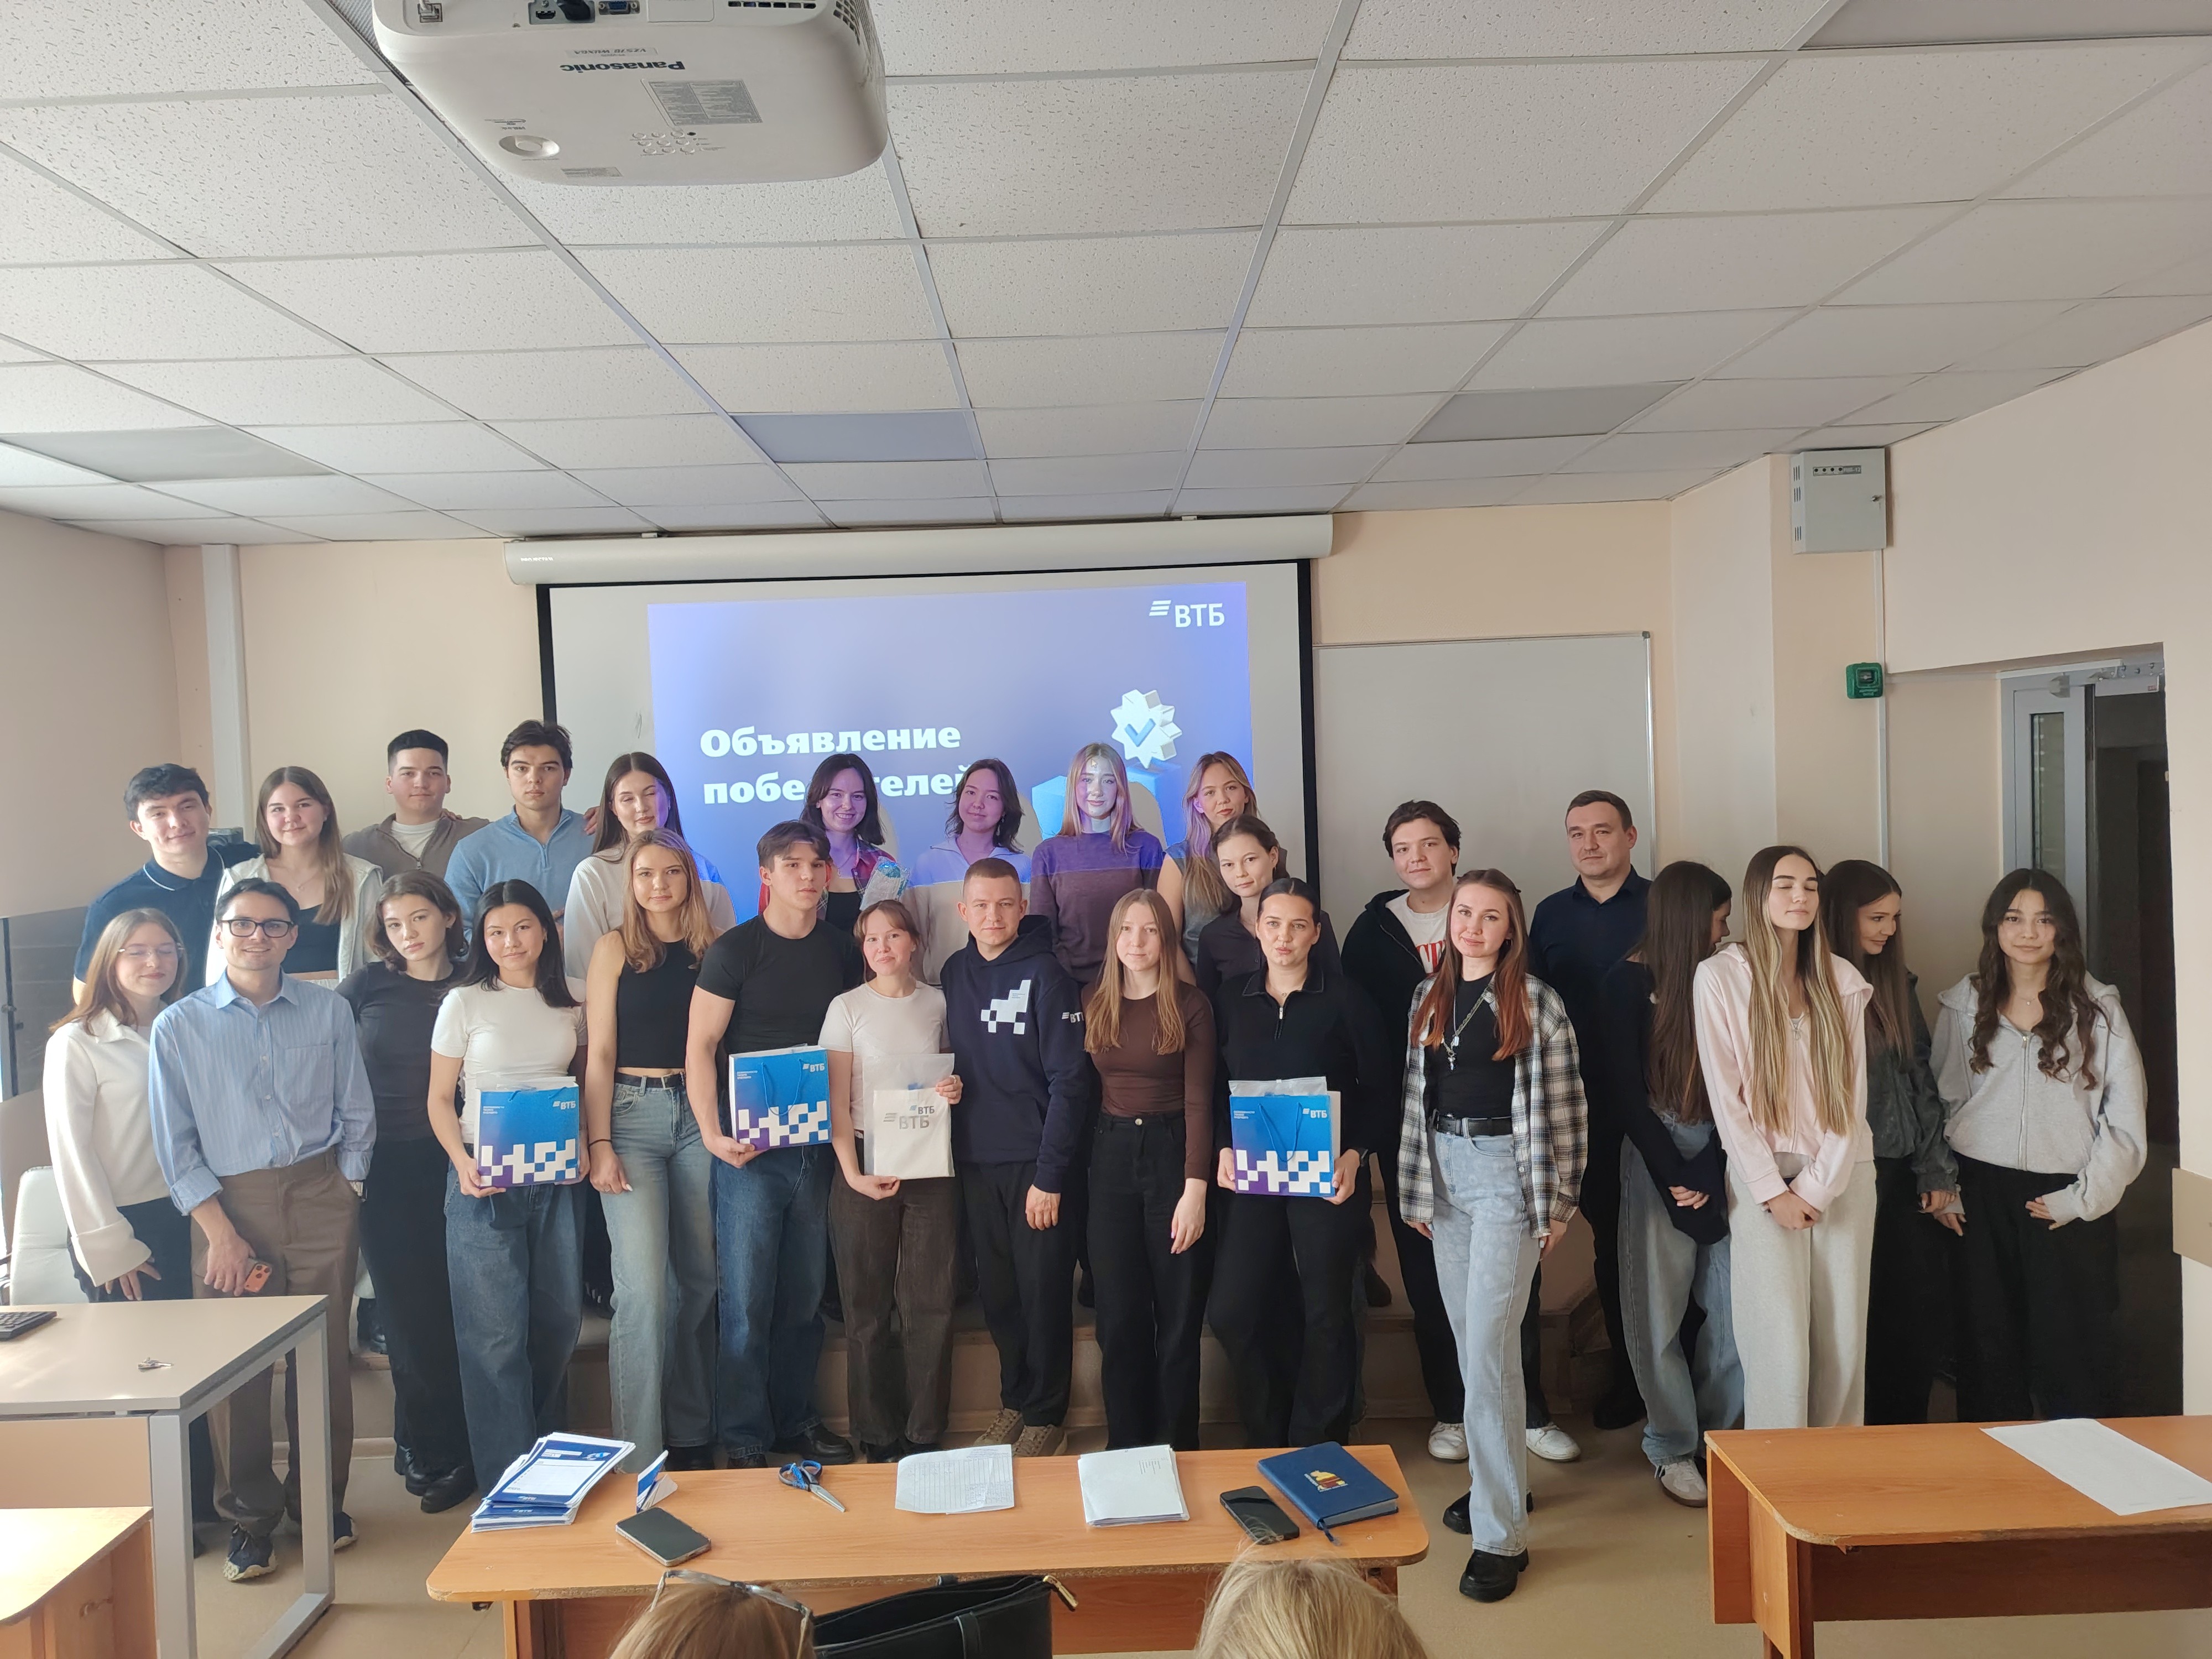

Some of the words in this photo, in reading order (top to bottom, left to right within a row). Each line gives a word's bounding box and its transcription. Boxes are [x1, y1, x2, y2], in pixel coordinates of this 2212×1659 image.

[560, 61, 685, 73] Panasonic
[1175, 603, 1225, 628] ВТБ
[700, 726, 961, 758] Объявление
[704, 765, 971, 804] побееле
[810, 1063, 825, 1072] ВТБ
[560, 1100, 576, 1110] ВТБ
[918, 1105, 935, 1114] ВТБ
[1310, 1110, 1327, 1118] ВТБ
[899, 1115, 930, 1129] ВТБ
